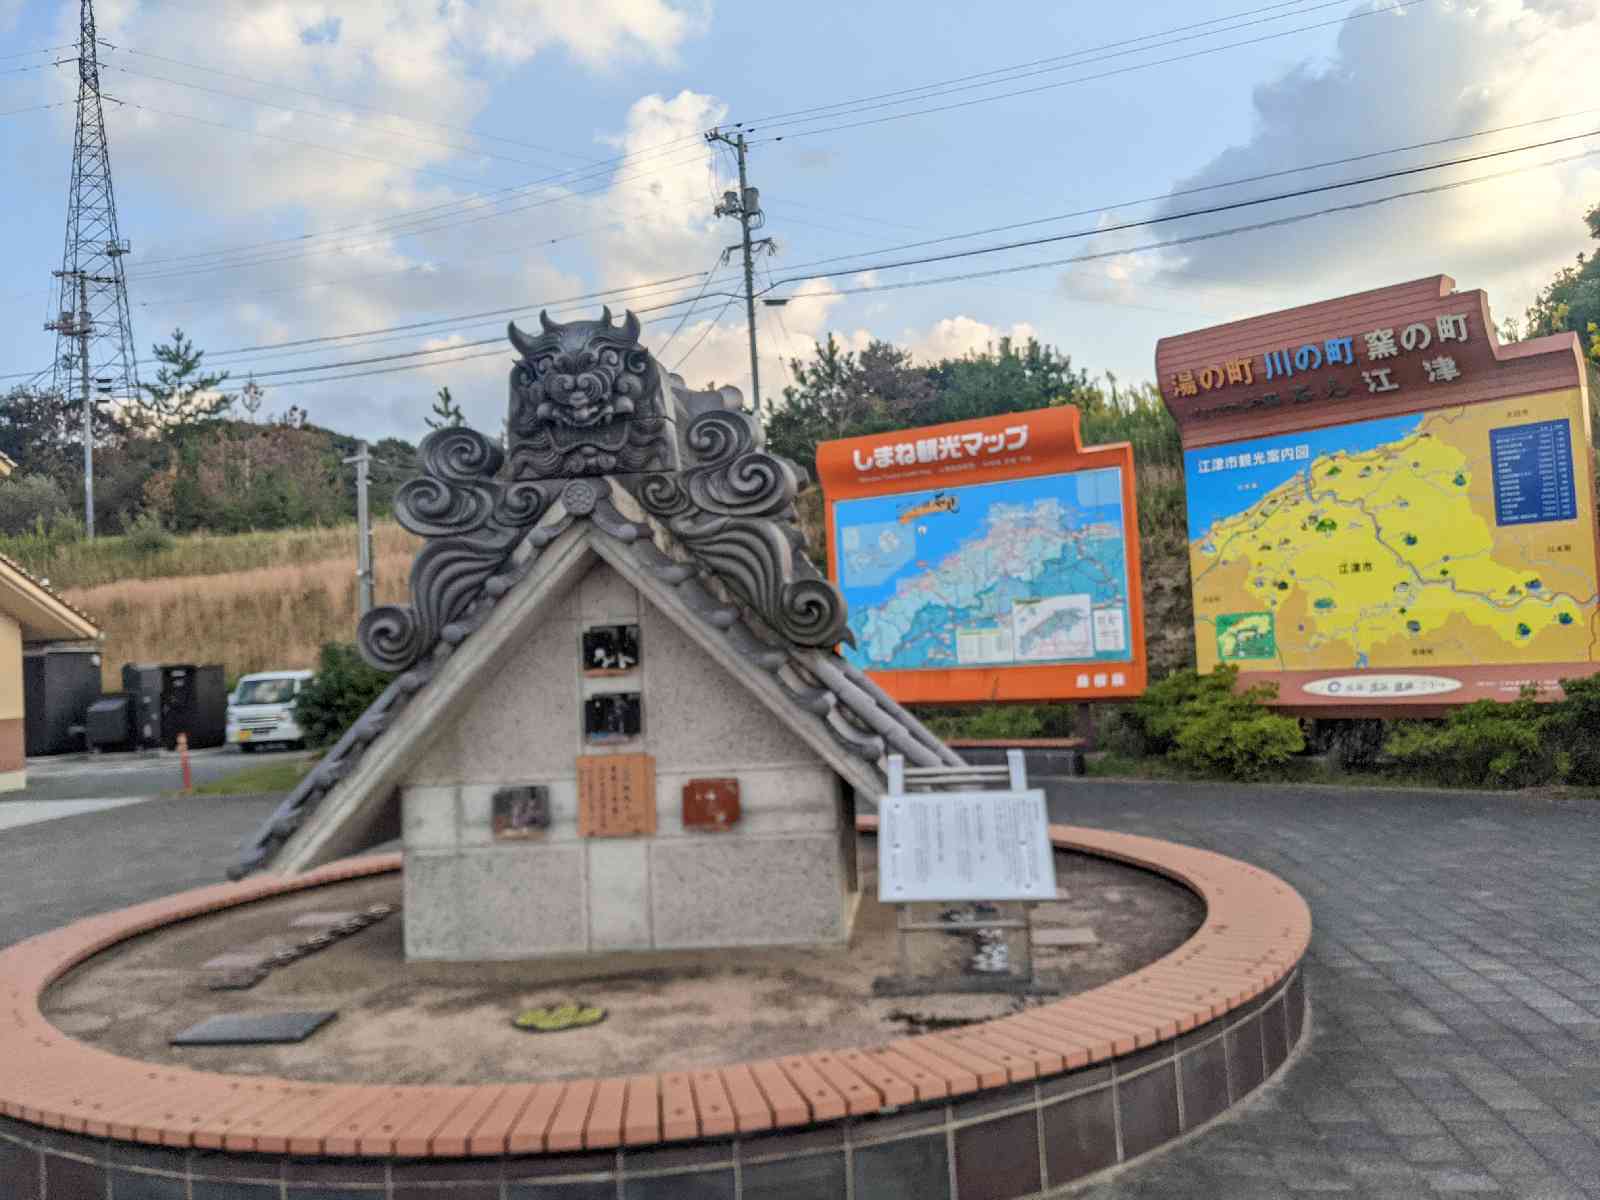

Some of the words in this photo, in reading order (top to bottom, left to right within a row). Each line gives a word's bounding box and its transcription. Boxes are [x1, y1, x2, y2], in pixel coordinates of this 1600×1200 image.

[1171, 356, 1256, 398] 湯の町
[1264, 335, 1354, 382] 川の町
[1363, 312, 1469, 361] 窯の町
[1362, 355, 1461, 393] 江津
[852, 424, 1029, 472] しまね観光マップ
[1198, 443, 1310, 474] 江津市観光案内図
